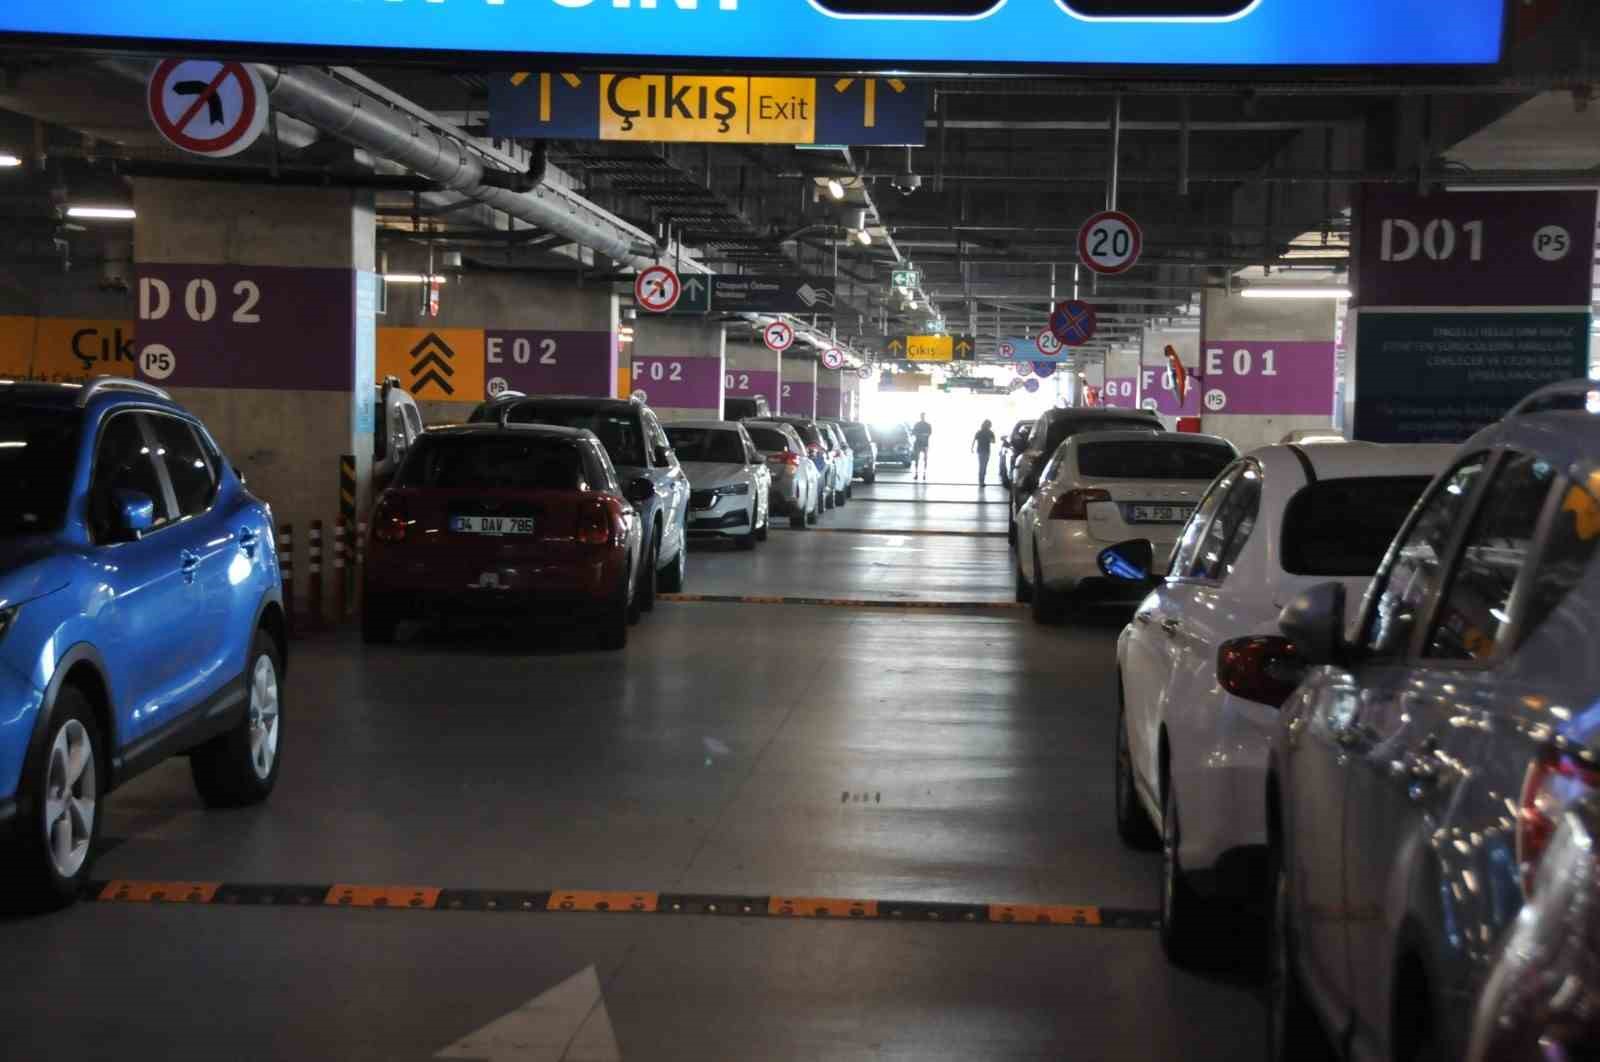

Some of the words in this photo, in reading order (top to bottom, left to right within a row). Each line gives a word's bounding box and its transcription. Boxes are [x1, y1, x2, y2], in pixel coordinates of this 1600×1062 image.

[606, 74, 737, 133] Çıkış
[758, 95, 809, 121] Exit
[1091, 227, 1129, 257] 20
[1380, 218, 1484, 262] D01
[1538, 234, 1565, 251] P5
[145, 353, 170, 371] P5
